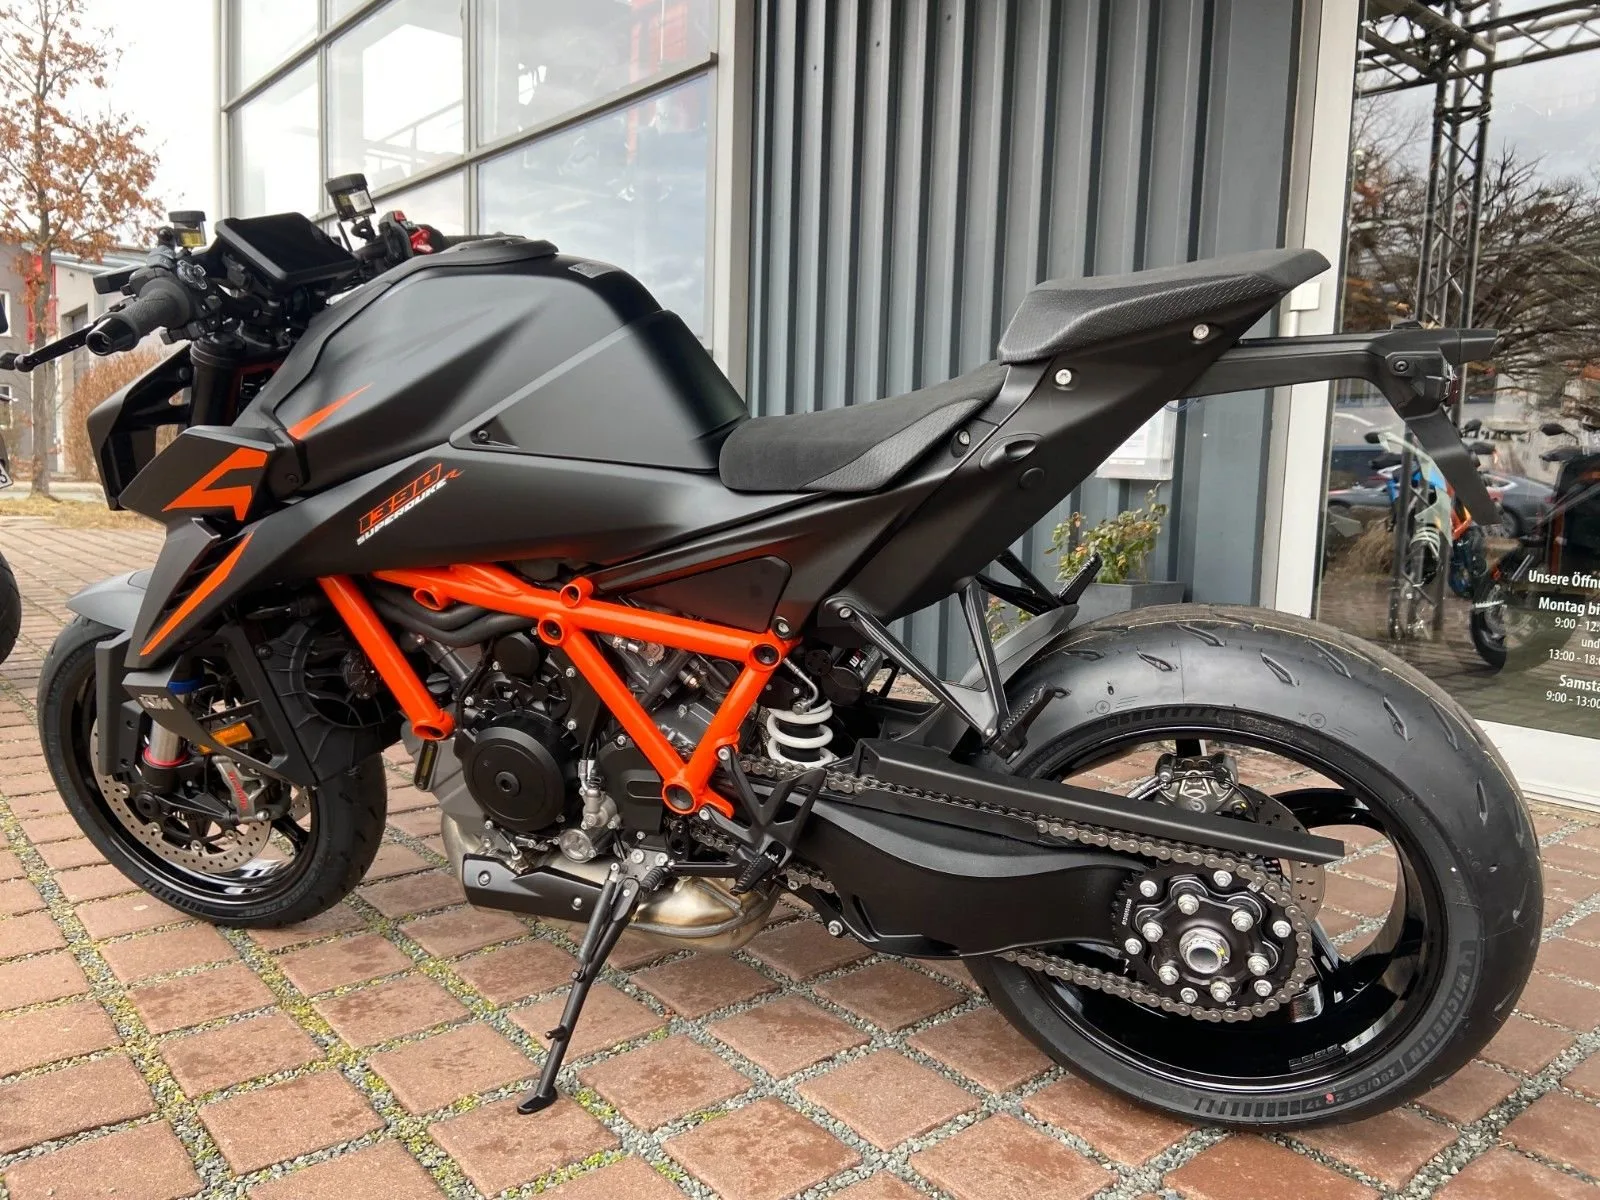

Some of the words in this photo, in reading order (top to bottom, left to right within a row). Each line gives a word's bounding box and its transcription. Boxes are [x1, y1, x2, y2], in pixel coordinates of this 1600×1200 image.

[356, 478, 447, 546] SUPERDUKE
[1528, 569, 1569, 586] Unsere
[1571, 571, 1600, 589] Öffn
[1538, 596, 1586, 617] Montag
[1554, 617, 1576, 629] 9:00
[1585, 620, 1600, 632] 12:
[1549, 648, 1575, 662] 13:00
[1546, 690, 1567, 703] 9:00
[1409, 970, 1470, 1065] MICHELIN
